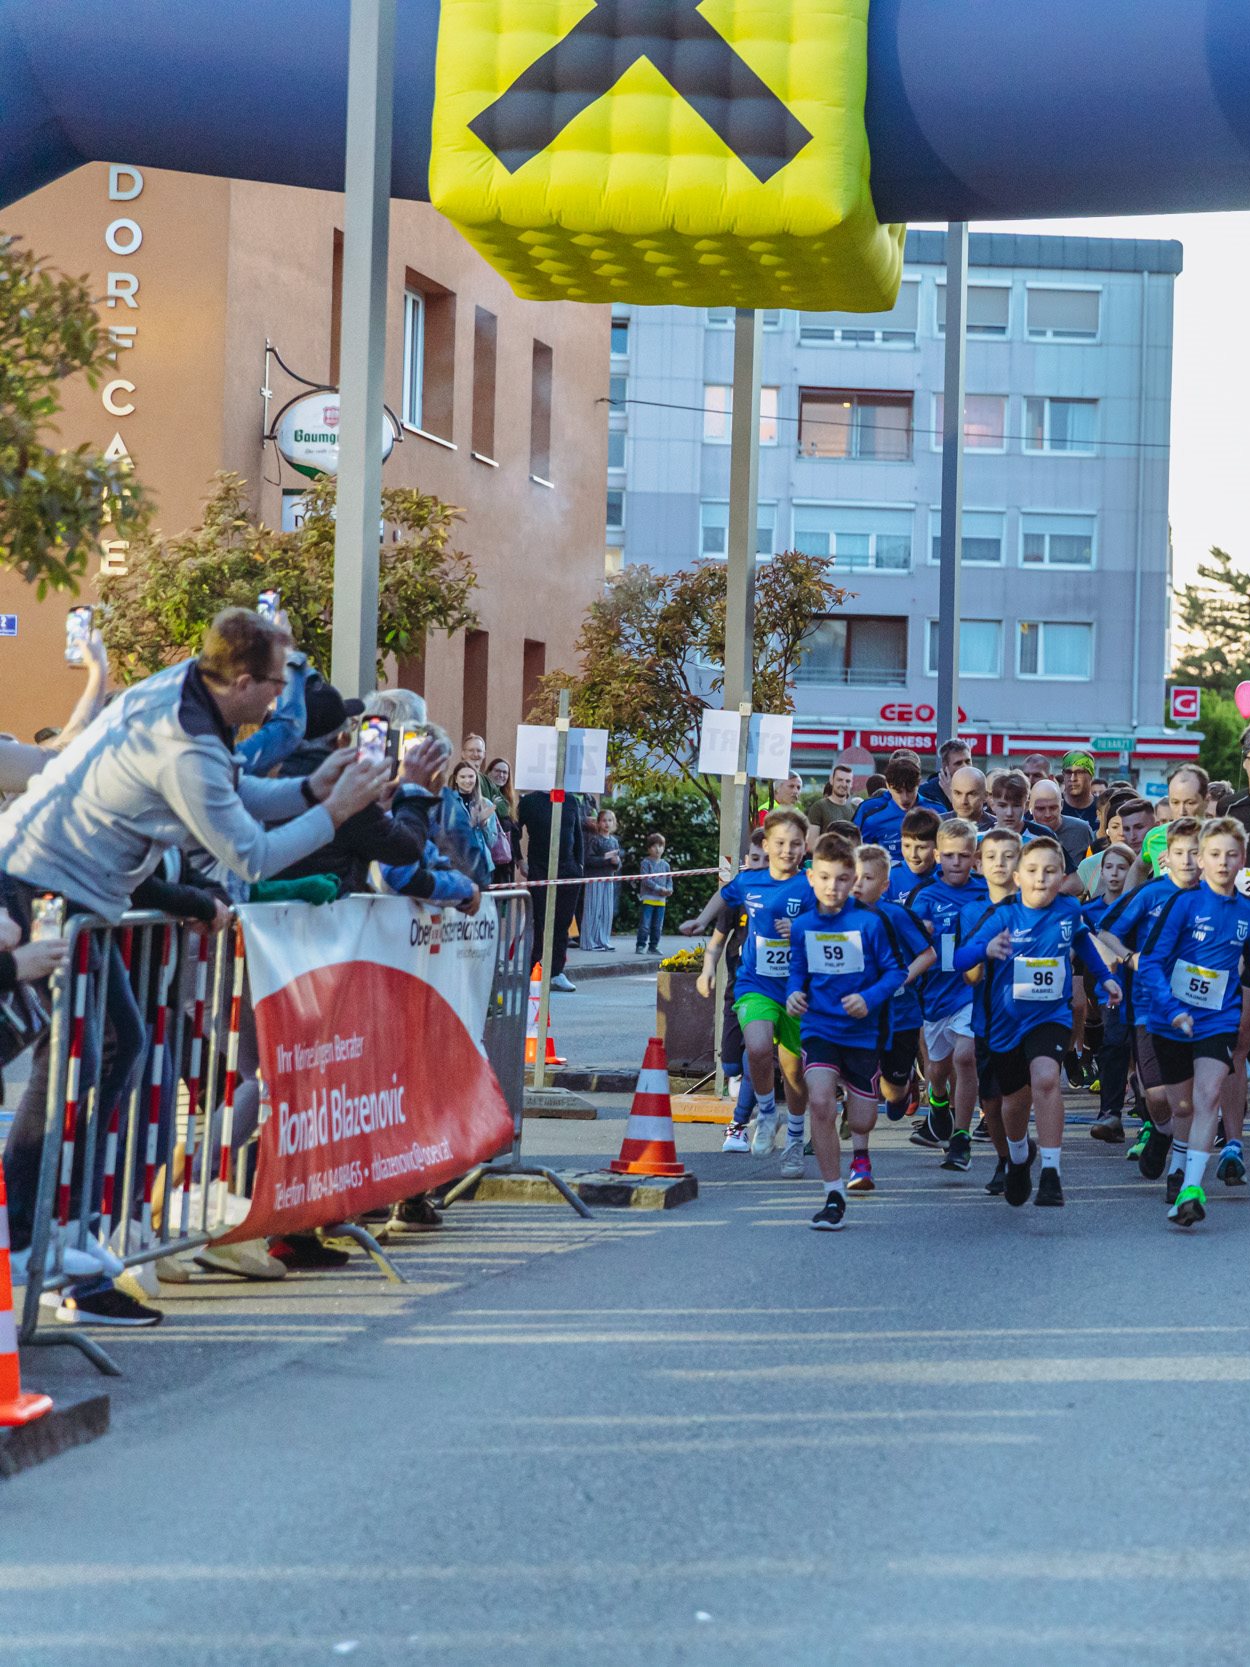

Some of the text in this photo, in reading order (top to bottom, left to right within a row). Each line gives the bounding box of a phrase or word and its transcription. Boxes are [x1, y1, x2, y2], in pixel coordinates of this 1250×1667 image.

[294, 429, 339, 446] Baumg
[870, 735, 931, 748] BUSINESS
[823, 945, 844, 960] 59
[1033, 971, 1054, 986] 96
[1189, 977, 1211, 995] 55
[277, 1043, 293, 1073] Ihr
[278, 1072, 407, 1157] Ronald Blazenovic
